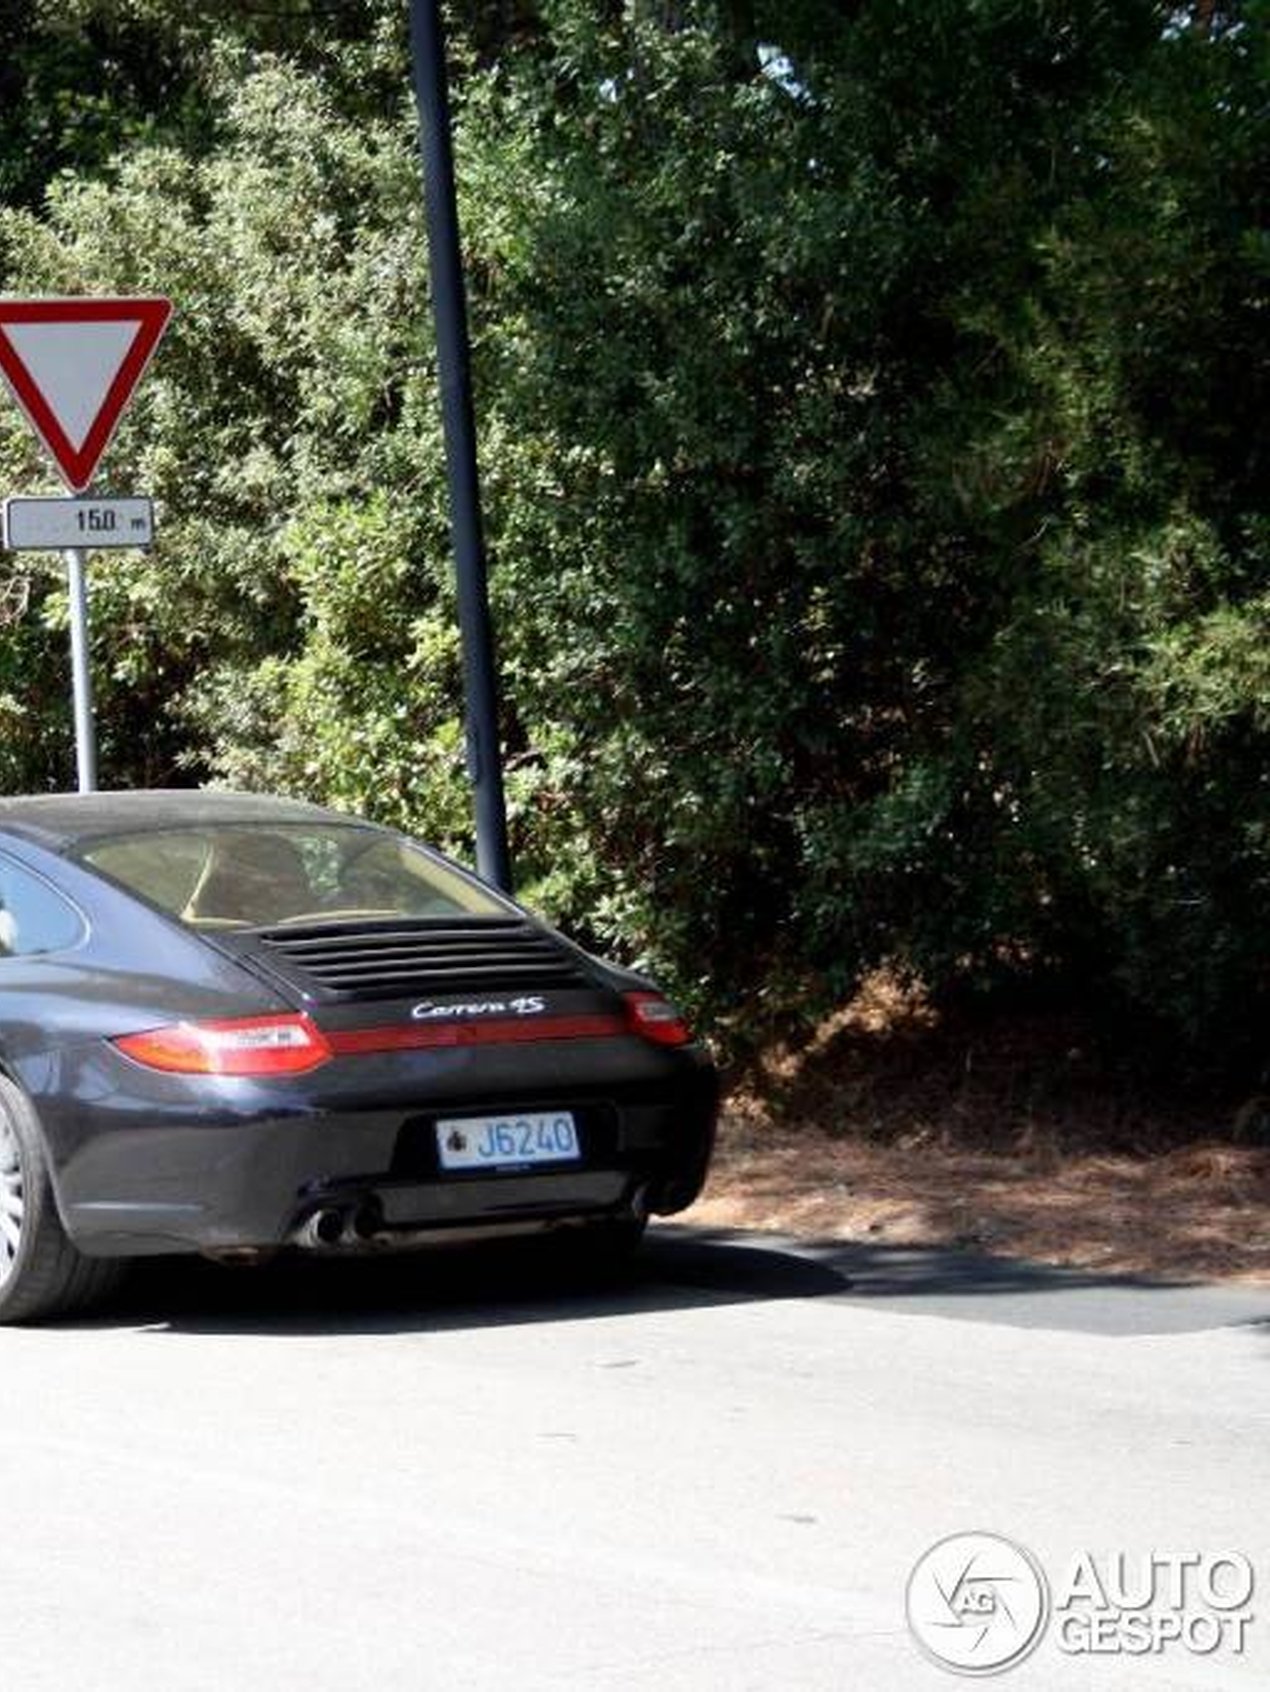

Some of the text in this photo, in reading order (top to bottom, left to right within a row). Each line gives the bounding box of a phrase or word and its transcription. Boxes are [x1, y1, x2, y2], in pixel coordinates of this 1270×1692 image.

[78, 509, 146, 531] 150 m
[412, 996, 544, 1018] Carrera 4S
[478, 1118, 573, 1157] J6240
